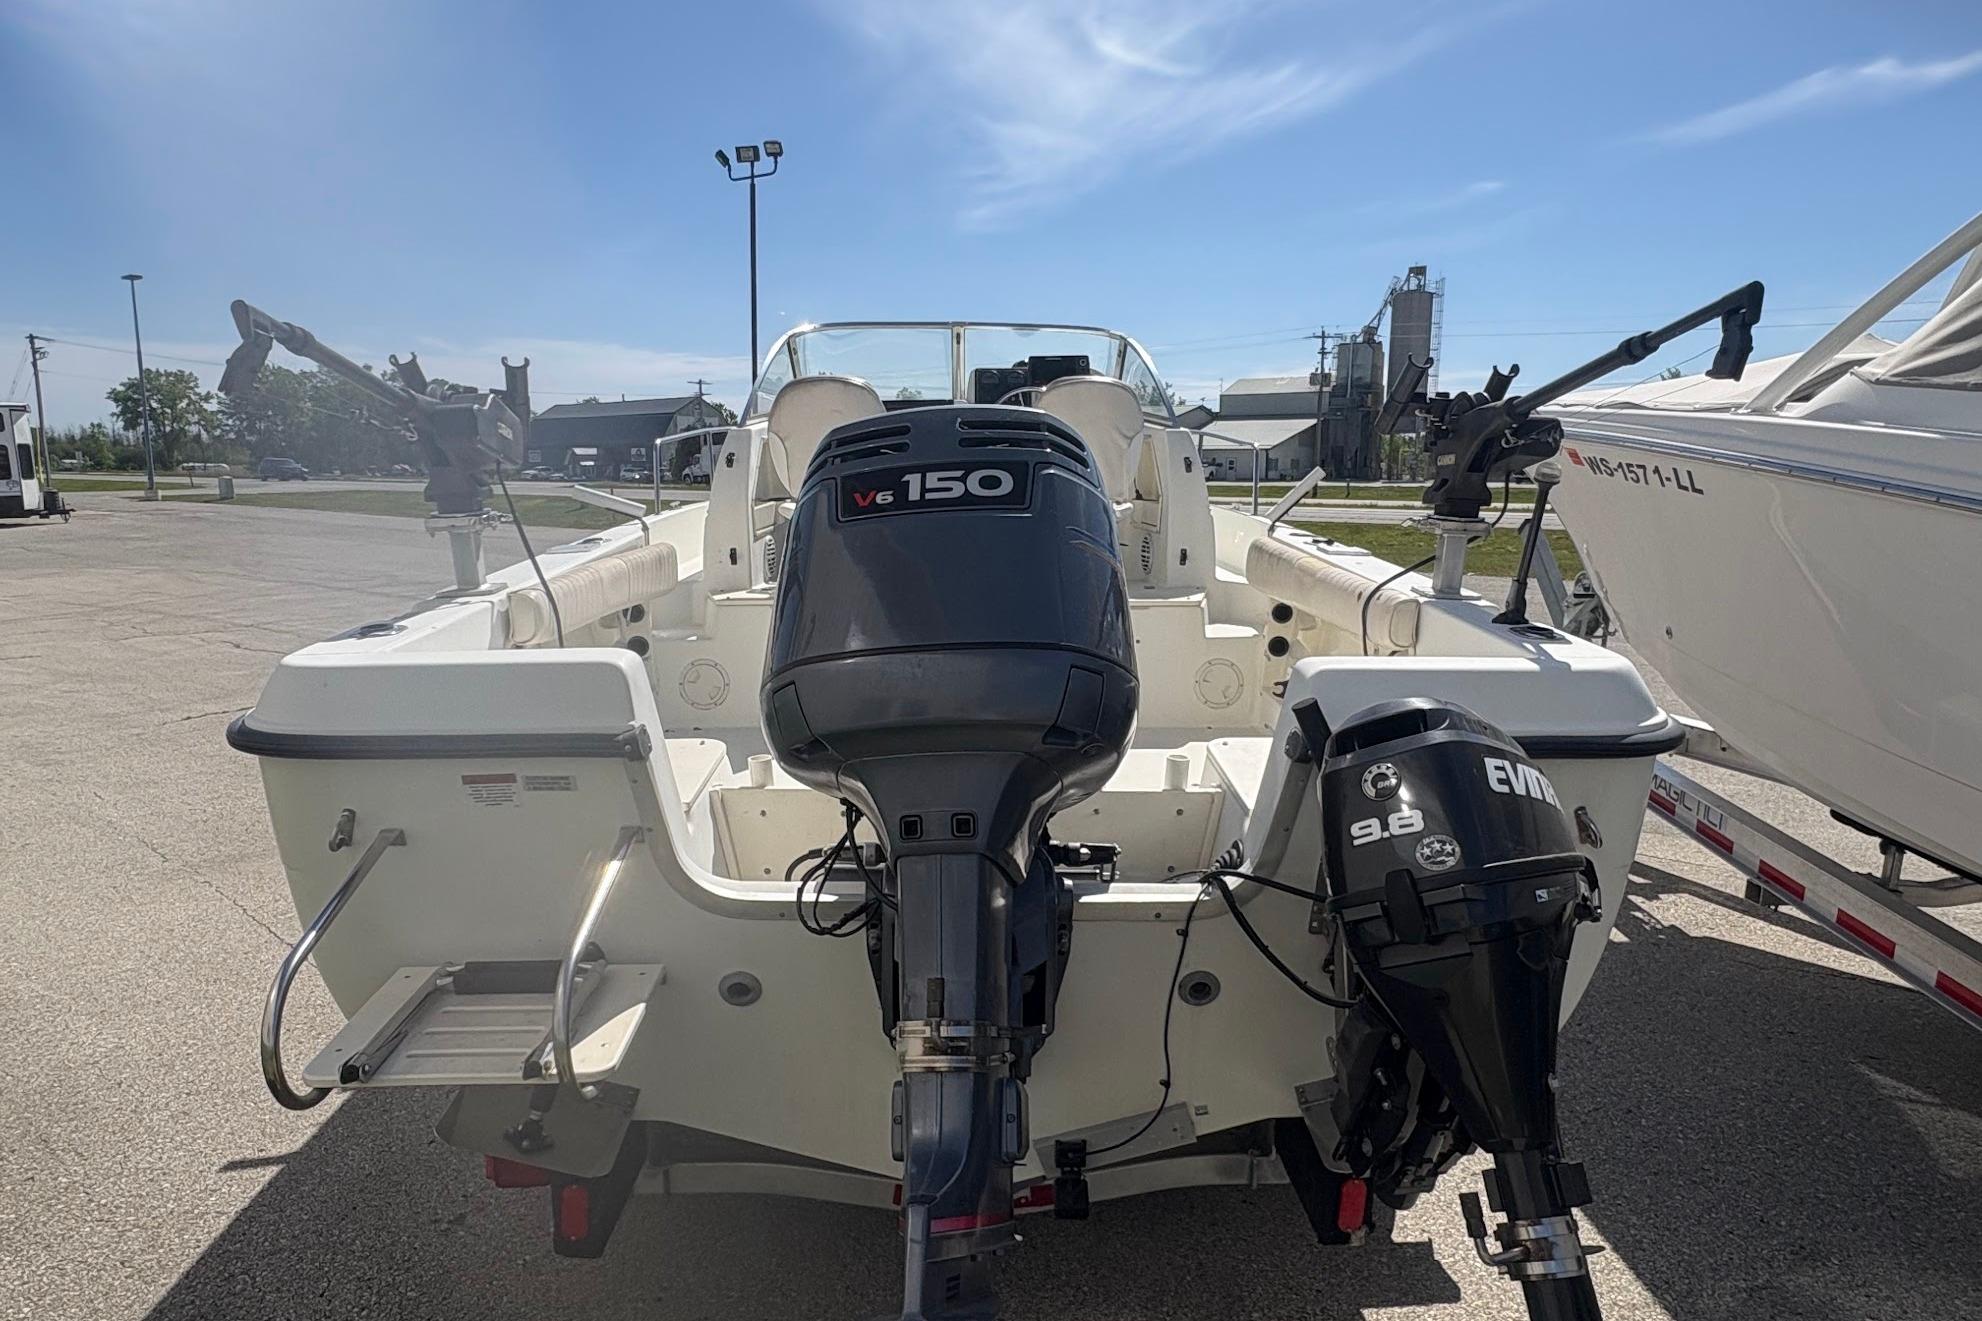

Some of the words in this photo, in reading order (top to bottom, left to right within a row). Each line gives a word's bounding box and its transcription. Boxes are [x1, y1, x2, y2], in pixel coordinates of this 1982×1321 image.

[853, 489, 895, 508] V6
[901, 468, 1014, 501] 150
[1350, 809, 1424, 847] 9.8
